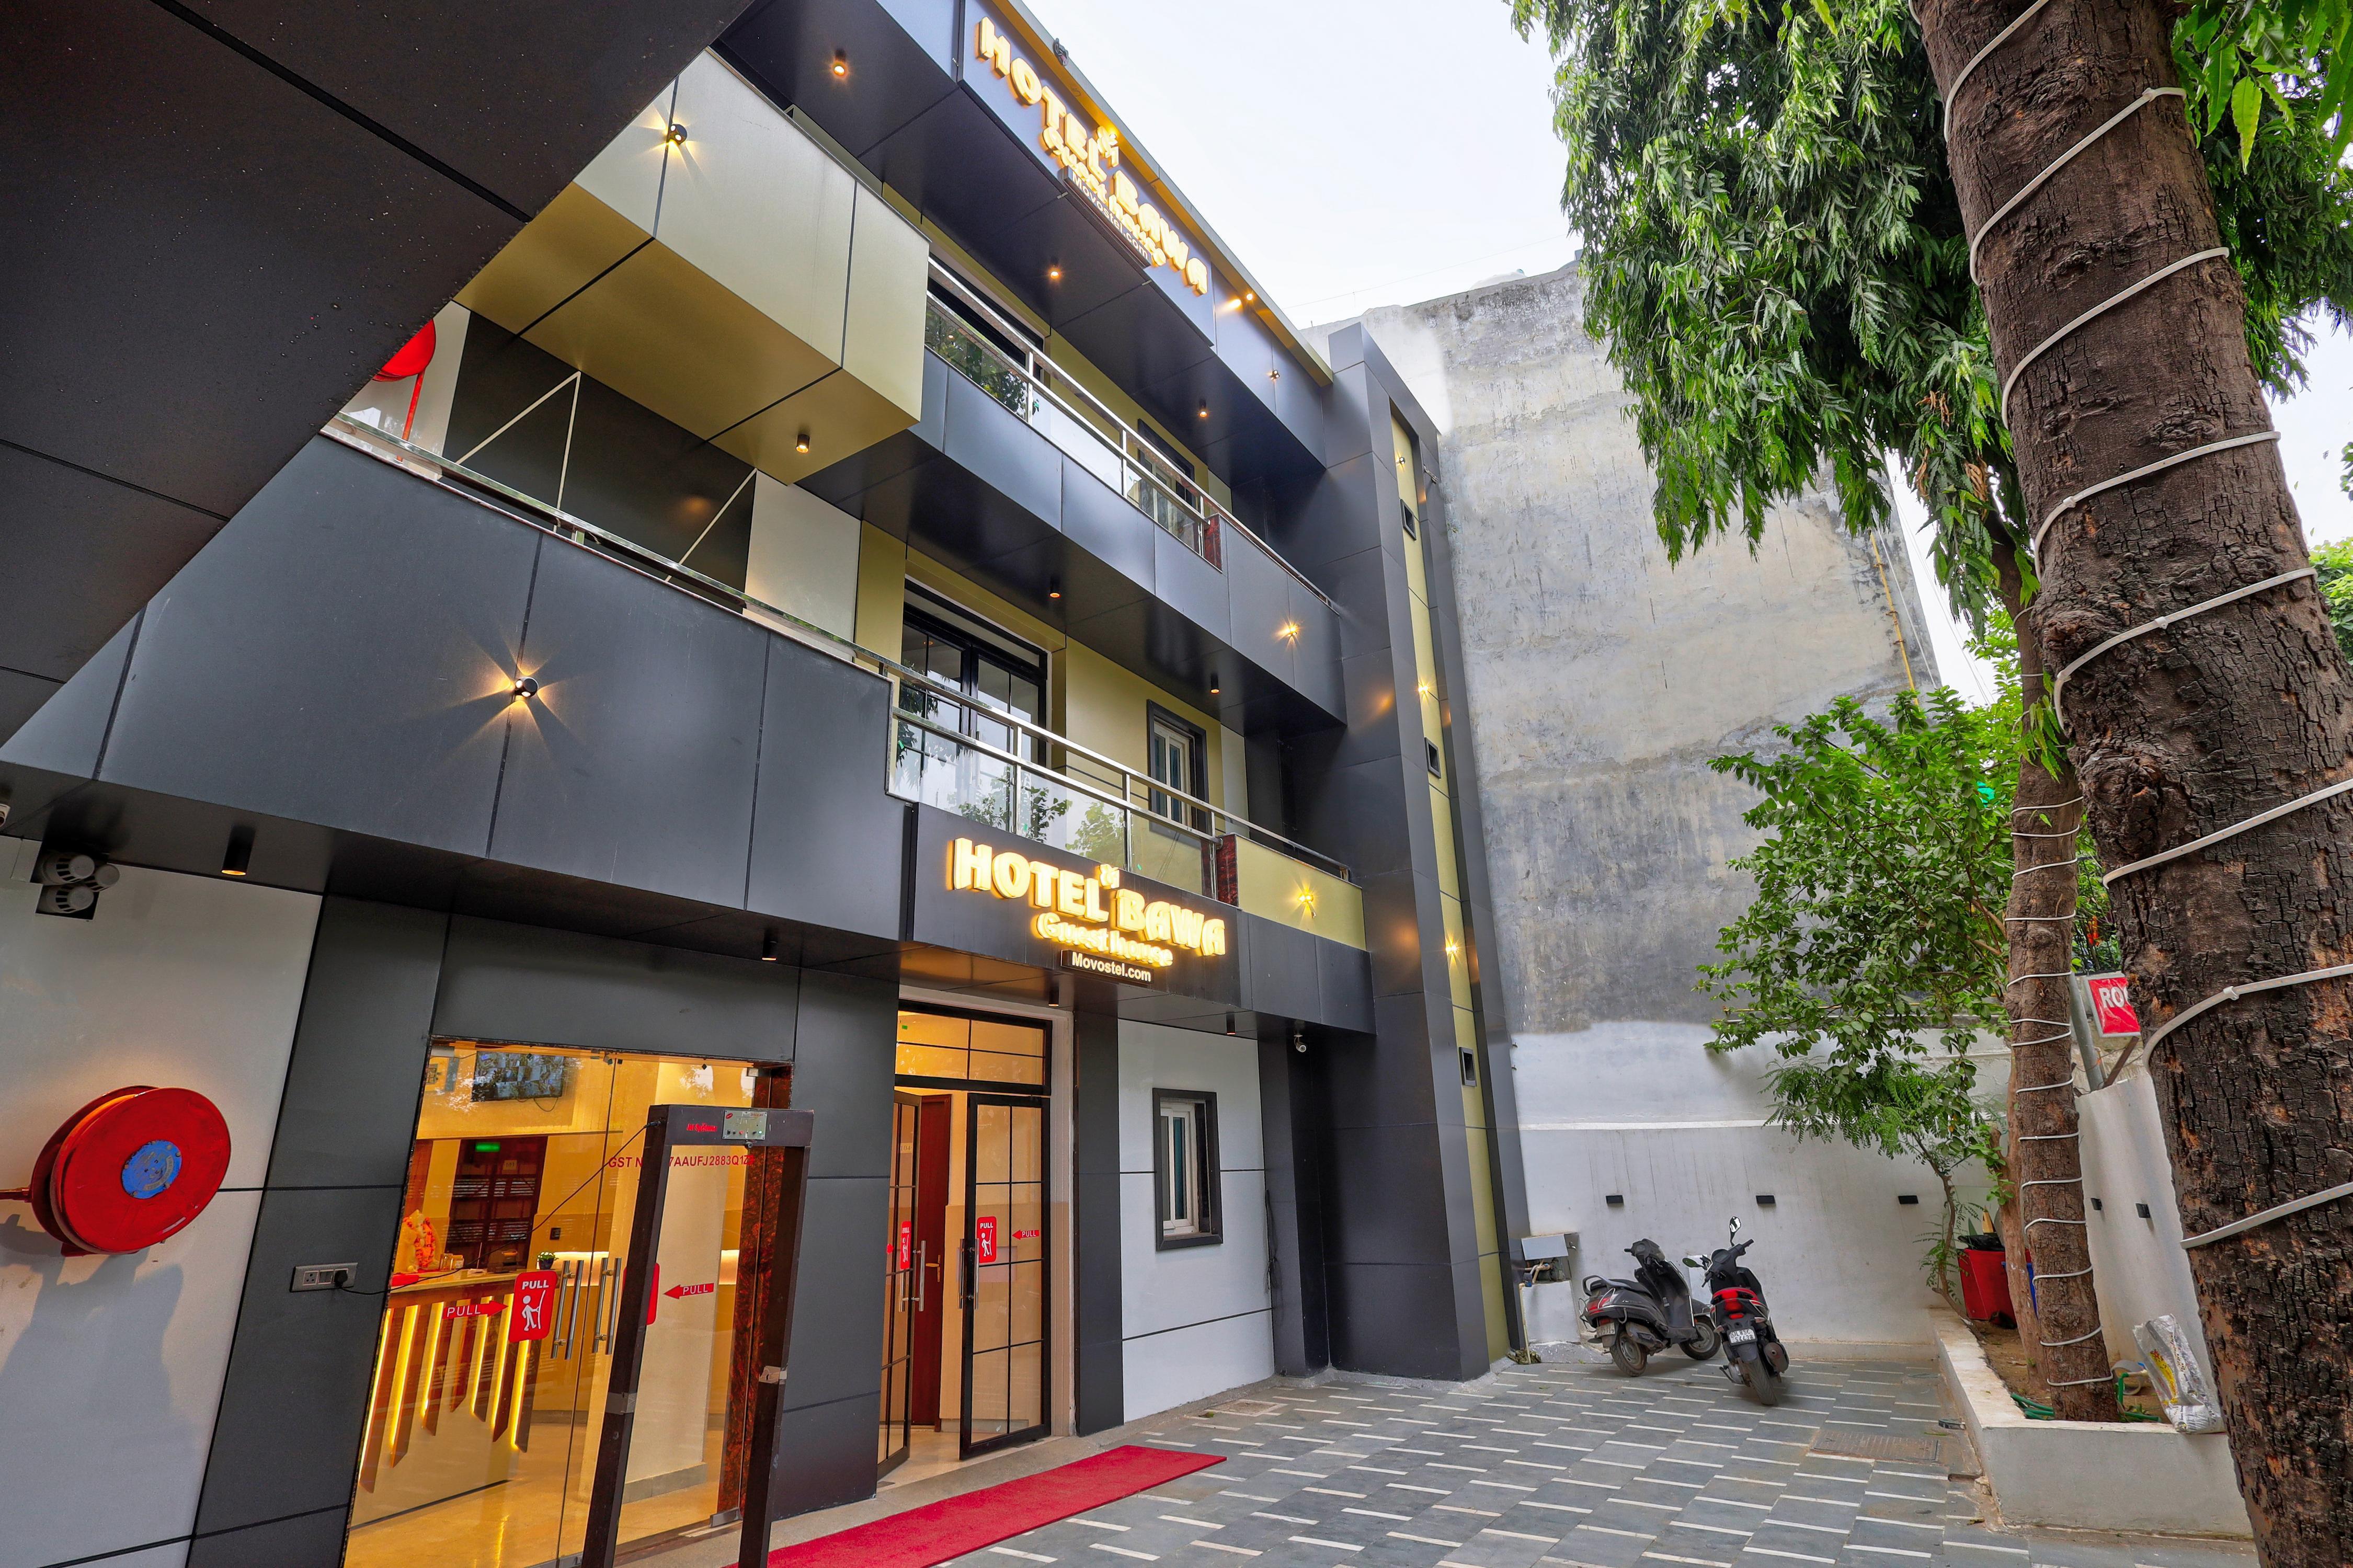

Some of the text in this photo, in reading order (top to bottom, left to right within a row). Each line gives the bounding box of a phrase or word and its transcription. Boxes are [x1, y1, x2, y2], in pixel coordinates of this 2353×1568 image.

[979, 17, 1208, 294] HOTEL BAWA
[1072, 171, 1150, 259] Movostel.com
[954, 837, 1226, 956] HOTEL BAWA
[1037, 912, 1109, 952] Guest
[1072, 952, 1151, 982] Movostel.com
[609, 1157, 632, 1168] GST
[522, 1280, 550, 1290] PULL
[683, 1284, 708, 1295] PULL
[447, 1304, 481, 1317] PULL
